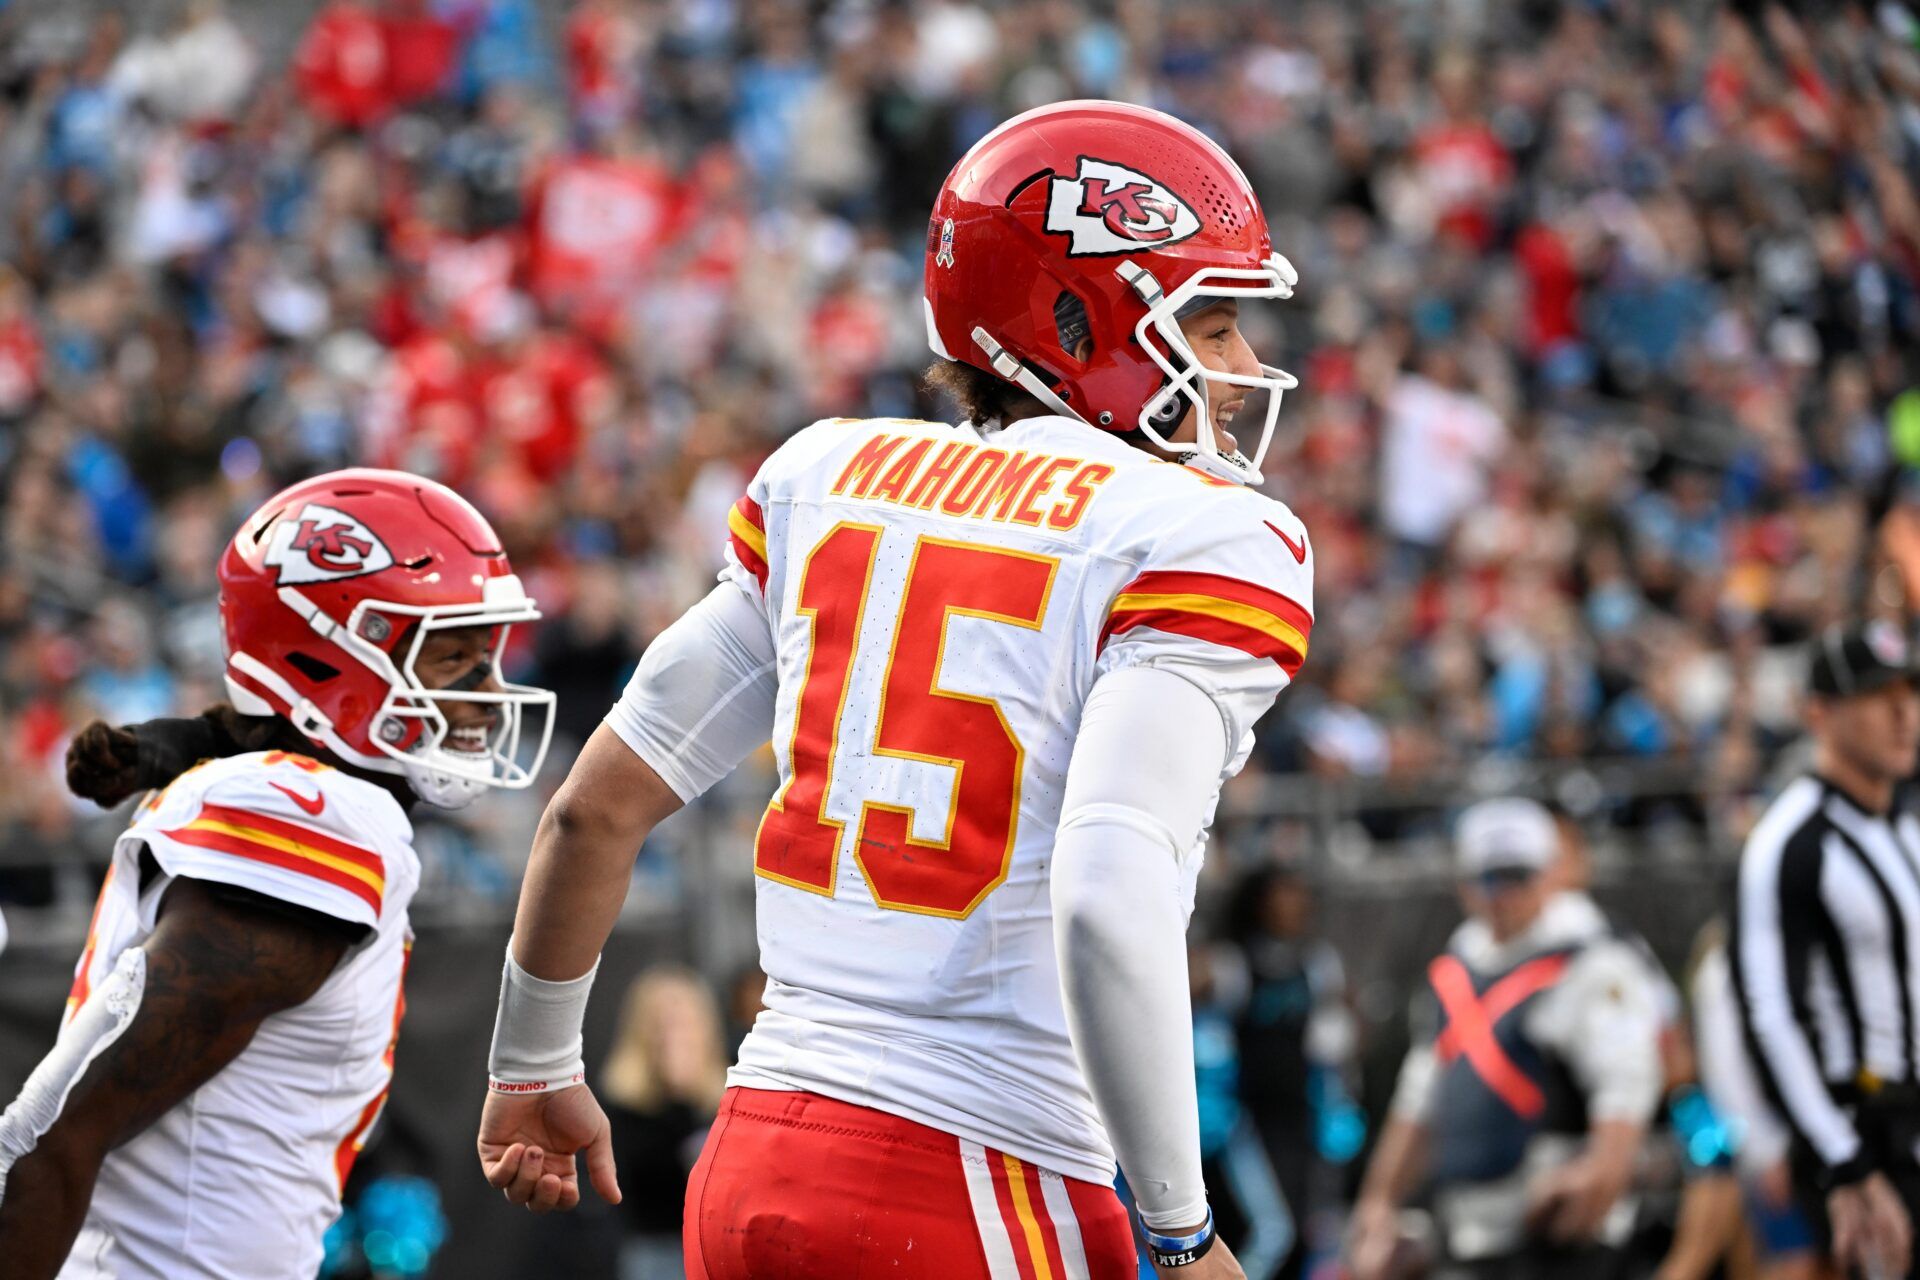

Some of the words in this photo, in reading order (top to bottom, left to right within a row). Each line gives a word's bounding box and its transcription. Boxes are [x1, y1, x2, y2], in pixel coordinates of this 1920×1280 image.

[1076, 177, 1179, 242] KC
[1063, 322, 1084, 341] 15
[829, 434, 1116, 532] MAHOMES
[288, 519, 374, 573] KC
[753, 520, 1061, 921] 15
[497, 1081, 548, 1092] COURAGE
[1158, 1251, 1196, 1267] TEAM
